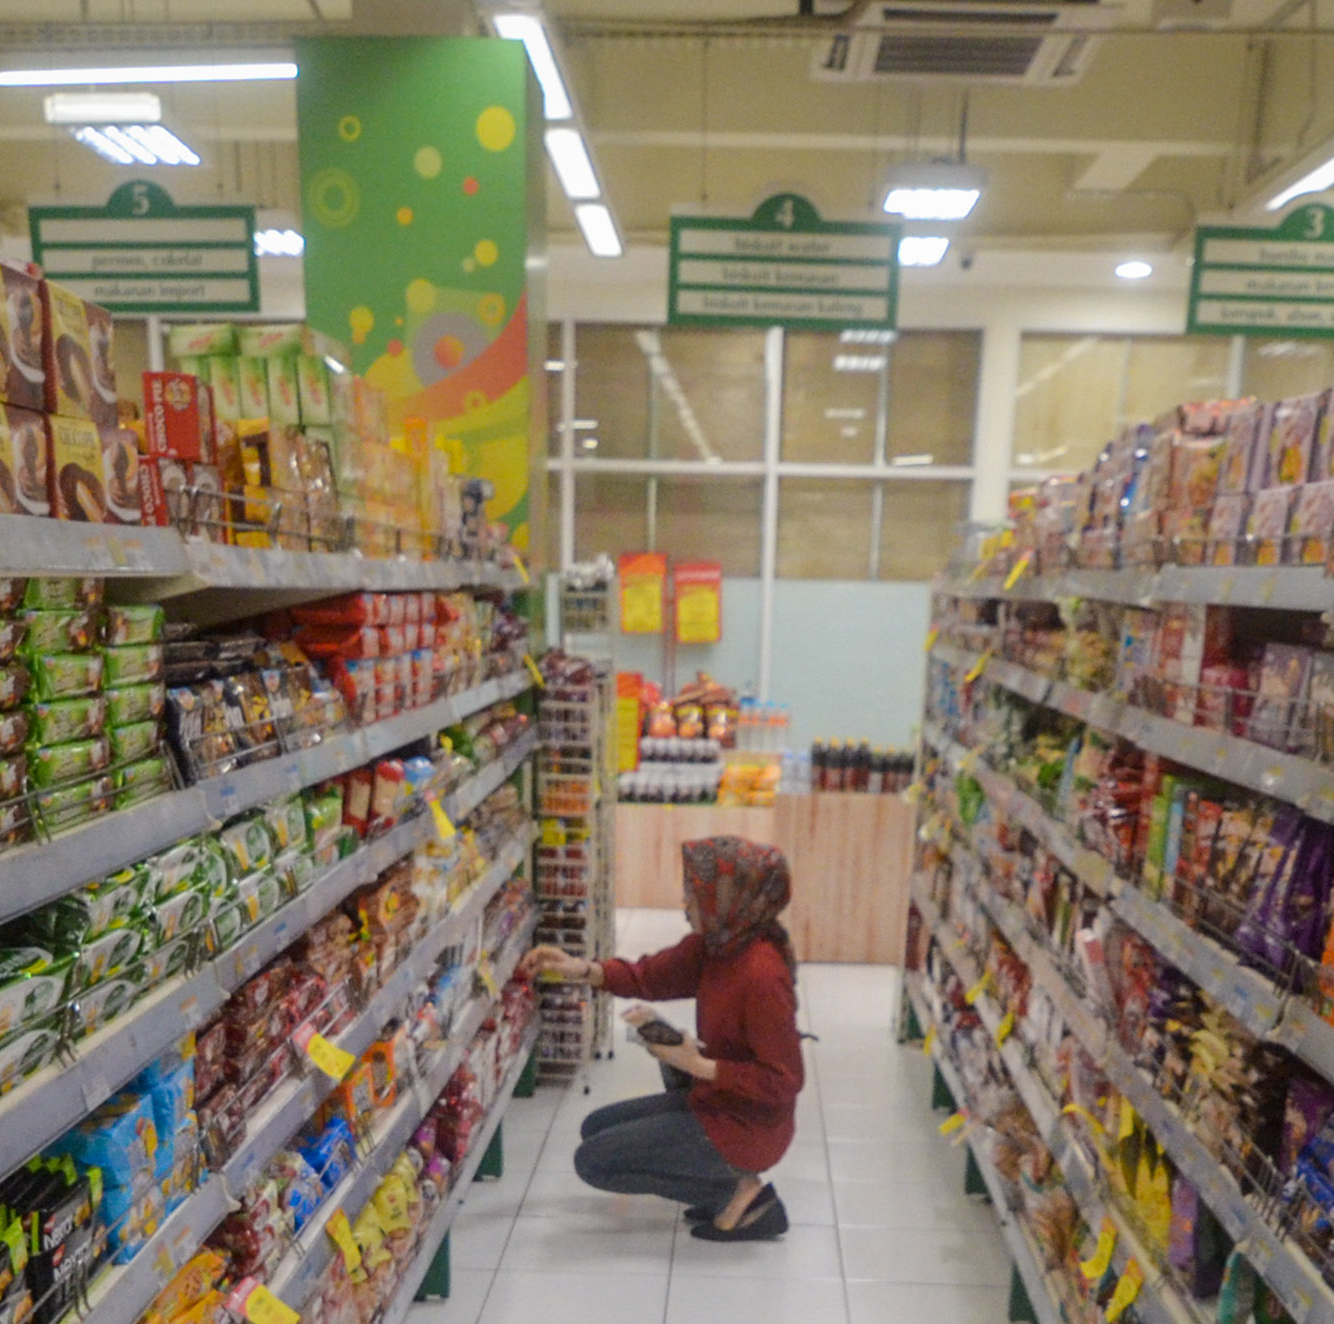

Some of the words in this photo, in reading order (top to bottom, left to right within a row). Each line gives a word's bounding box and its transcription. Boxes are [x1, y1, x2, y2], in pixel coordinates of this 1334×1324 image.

[132, 185, 150, 215] 5
[774, 200, 794, 228] 4
[1304, 208, 1325, 239] 3
